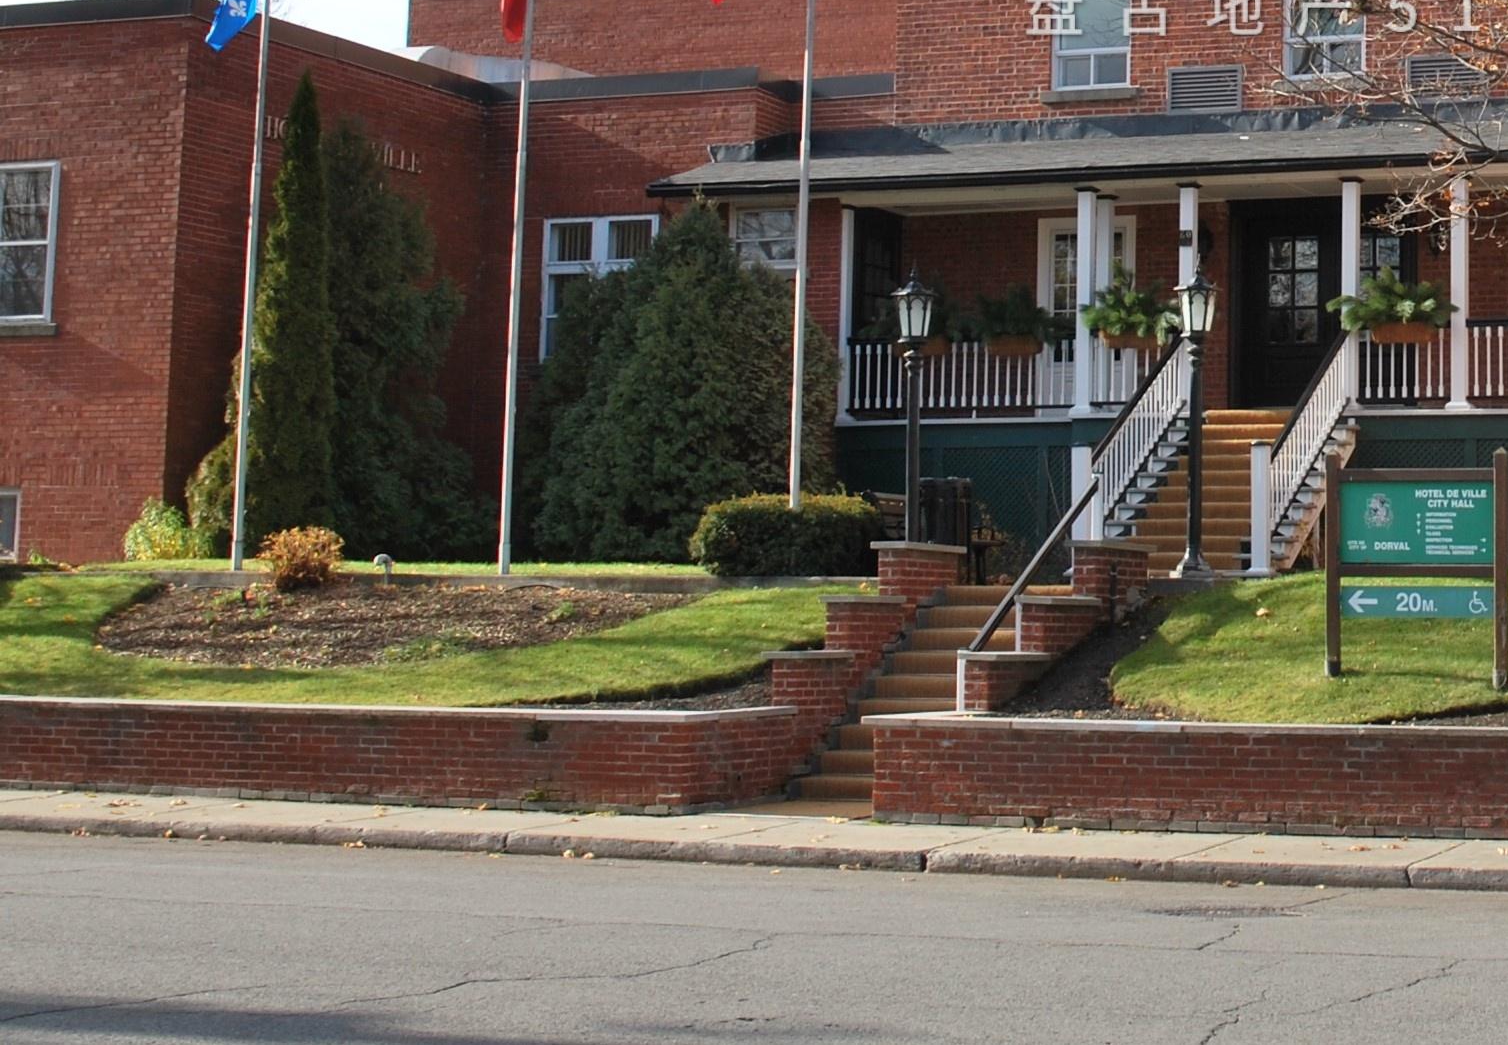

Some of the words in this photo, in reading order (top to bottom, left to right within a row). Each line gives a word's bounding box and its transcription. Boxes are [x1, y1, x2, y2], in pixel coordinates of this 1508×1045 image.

[1415, 489, 1444, 498] HOTEL
[1446, 489, 1459, 498] DE
[1461, 489, 1487, 498] VILLE
[1427, 499, 1449, 508] CITY
[1451, 499, 1475, 508] HALL
[1374, 541, 1411, 551] DORVAL
